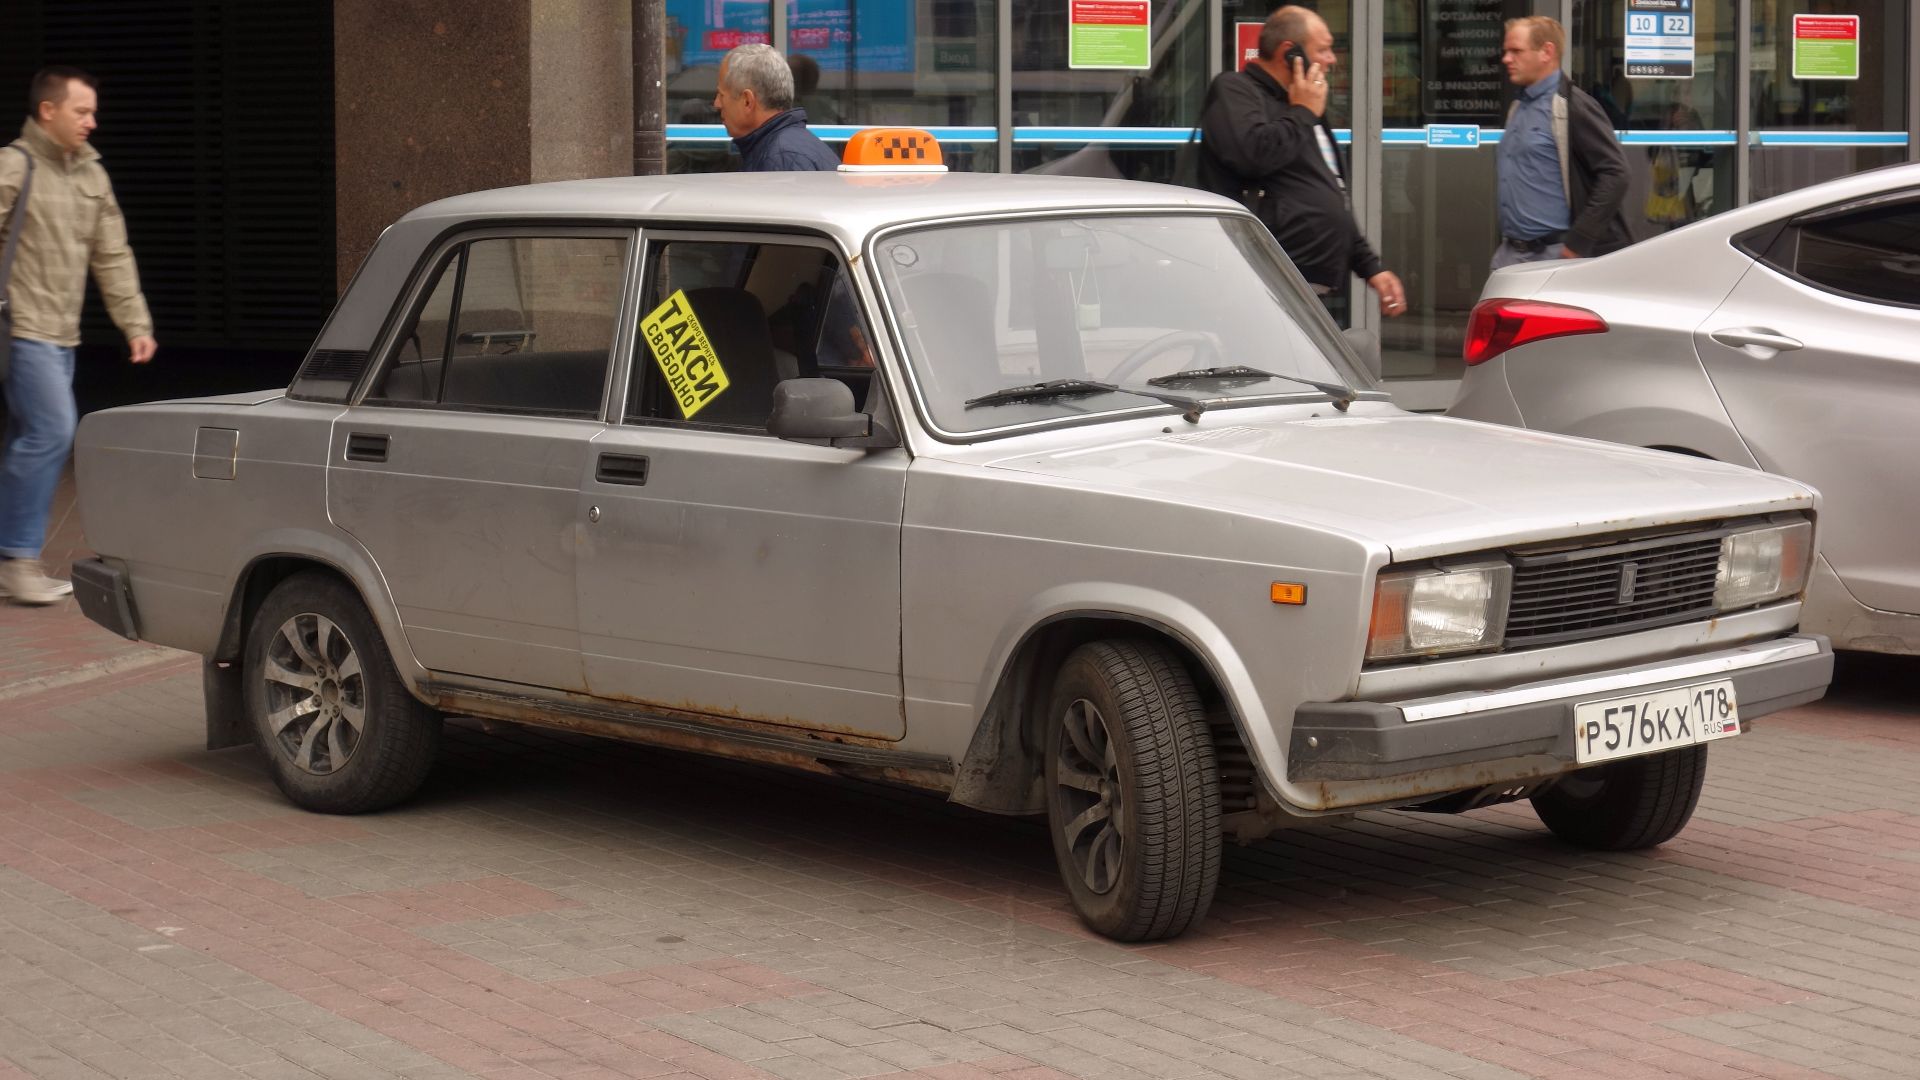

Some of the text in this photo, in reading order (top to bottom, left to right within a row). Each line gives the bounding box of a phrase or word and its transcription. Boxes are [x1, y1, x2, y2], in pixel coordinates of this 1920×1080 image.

[1636, 17, 1685, 31] 10 22
[659, 298, 720, 402] ТАКСИ
[686, 314, 716, 366] СКОРО ВЕРНУСЬ
[647, 323, 695, 408] СВОБОДНО
[1694, 687, 1729, 723] 178
[1704, 722, 1723, 735] RUS
